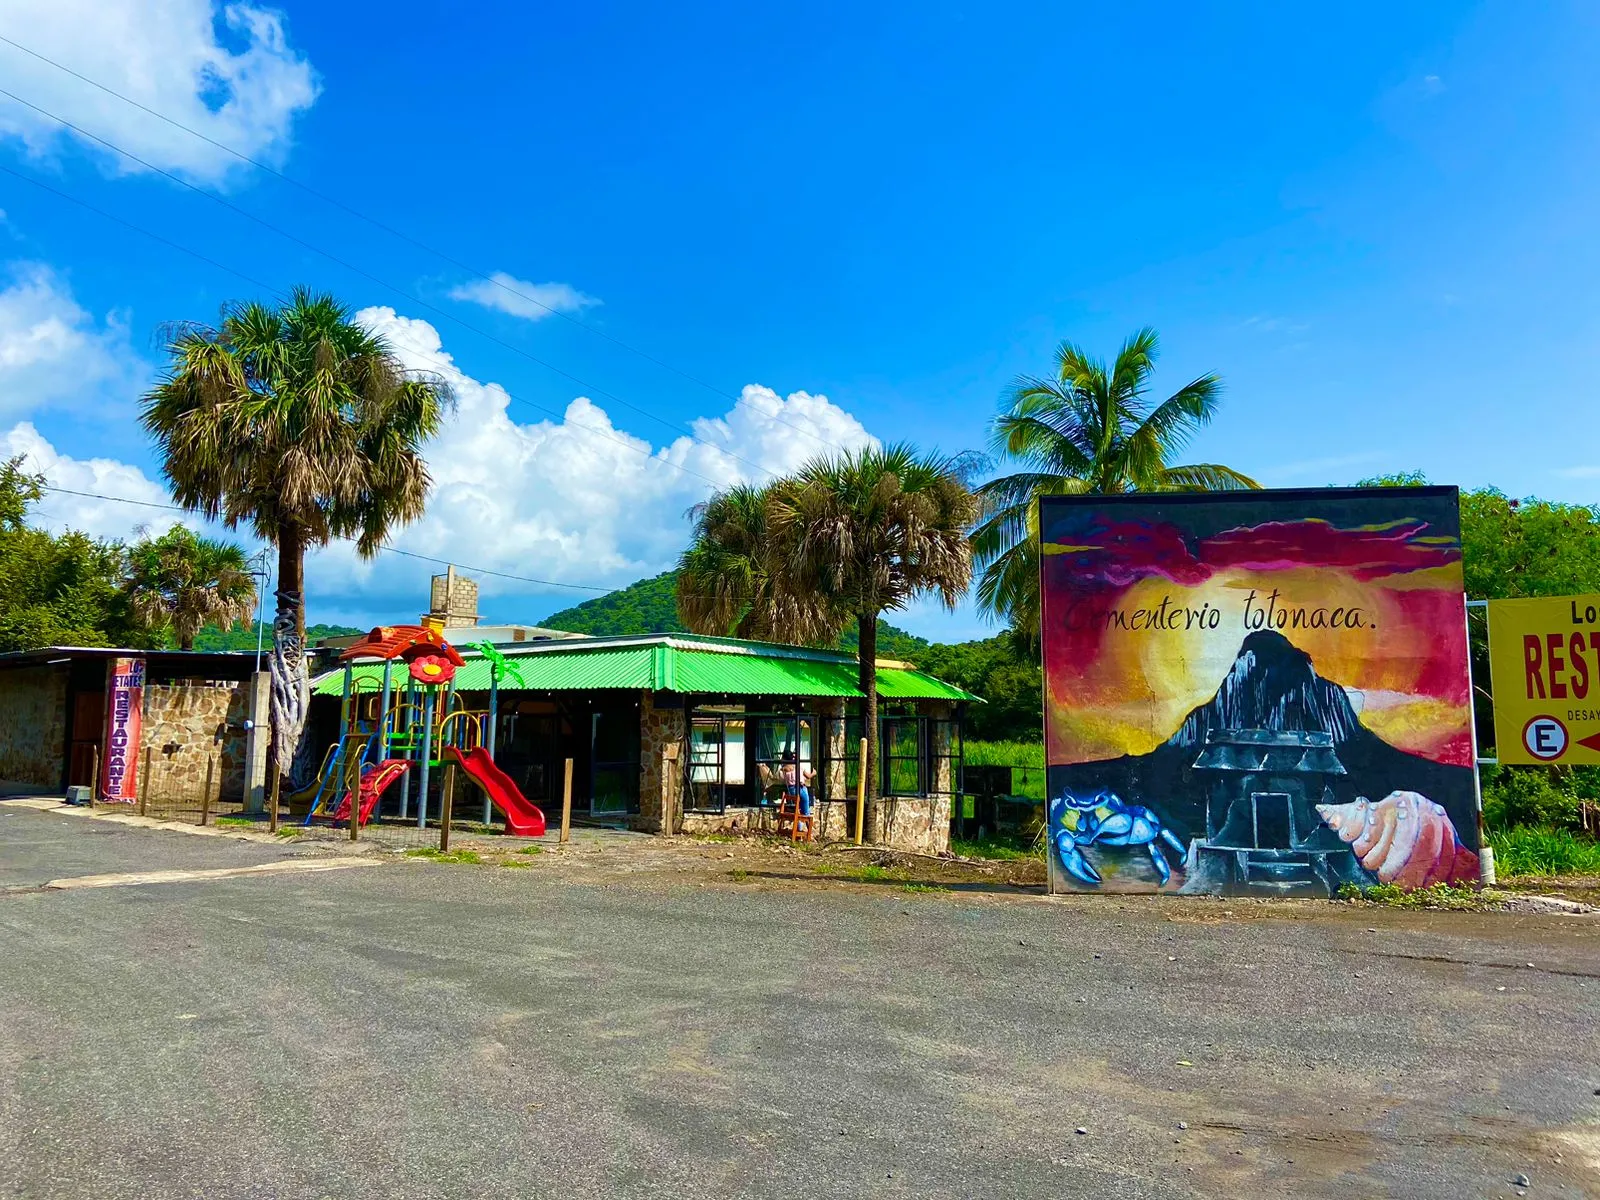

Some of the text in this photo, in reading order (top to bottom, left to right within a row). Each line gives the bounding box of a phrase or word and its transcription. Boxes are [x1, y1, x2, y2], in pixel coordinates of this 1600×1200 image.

[1243, 588, 1377, 630] totonaca.
[1571, 600, 1600, 624] Lo
[108, 690, 130, 795] RESTAURANTE
[1534, 724, 1558, 752] E
